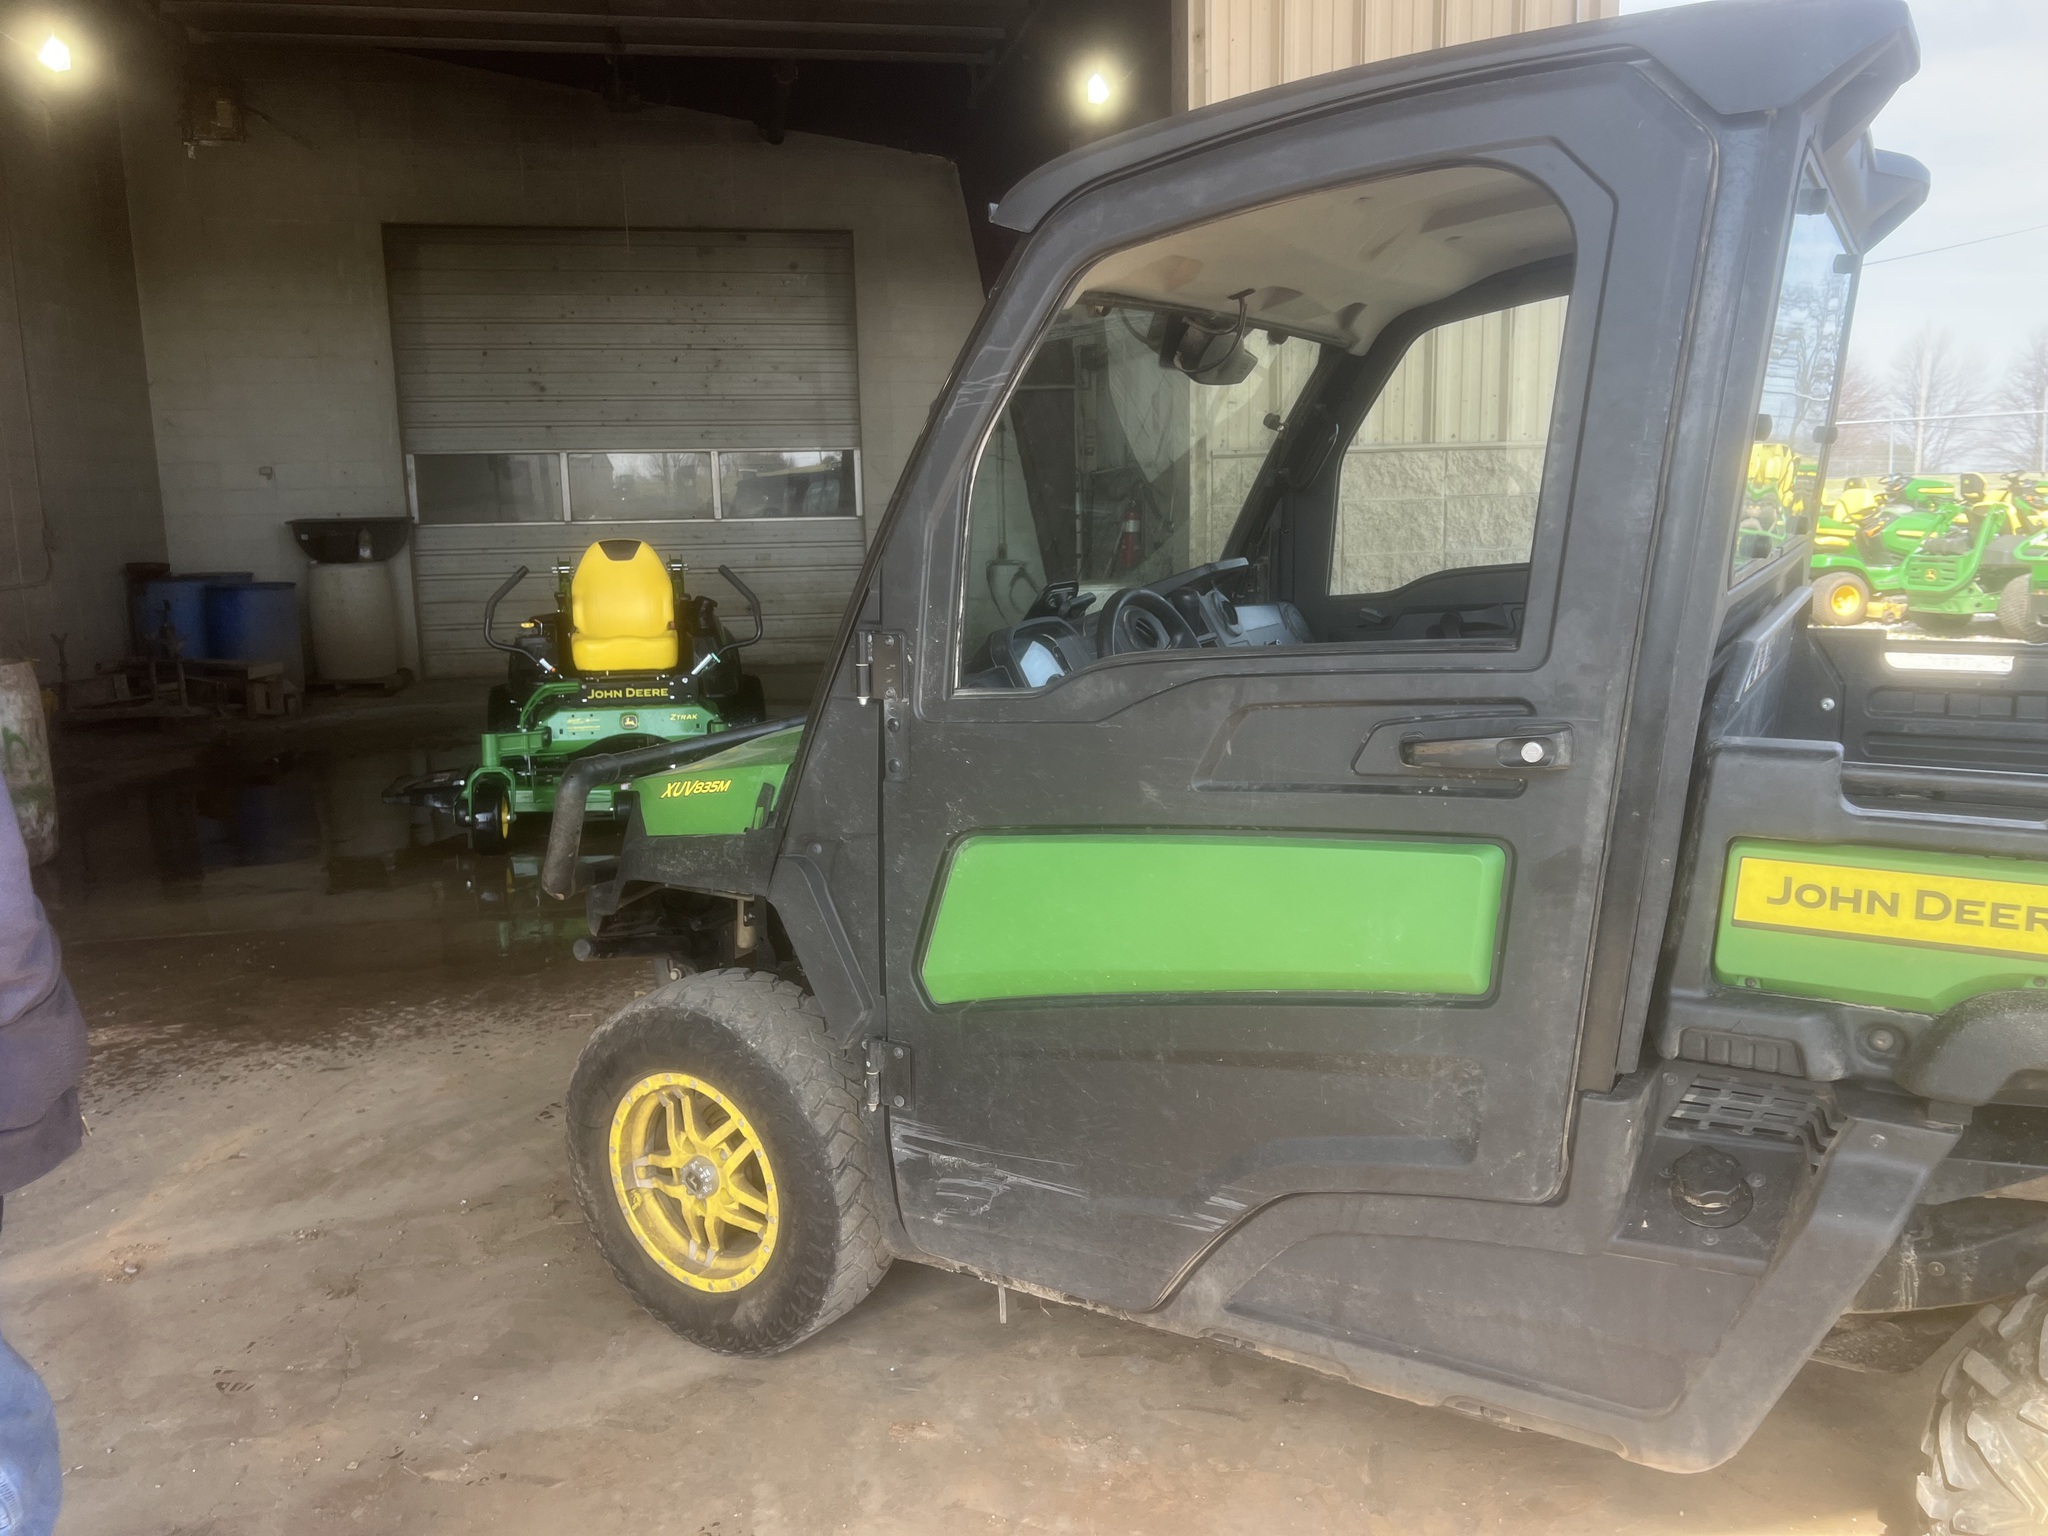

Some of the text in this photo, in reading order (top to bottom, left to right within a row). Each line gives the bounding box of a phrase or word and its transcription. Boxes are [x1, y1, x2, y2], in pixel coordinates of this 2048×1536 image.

[587, 687, 669, 699] JOHN DEERE
[660, 779, 732, 798] XUV835M
[1766, 876, 1900, 918] JOHN
